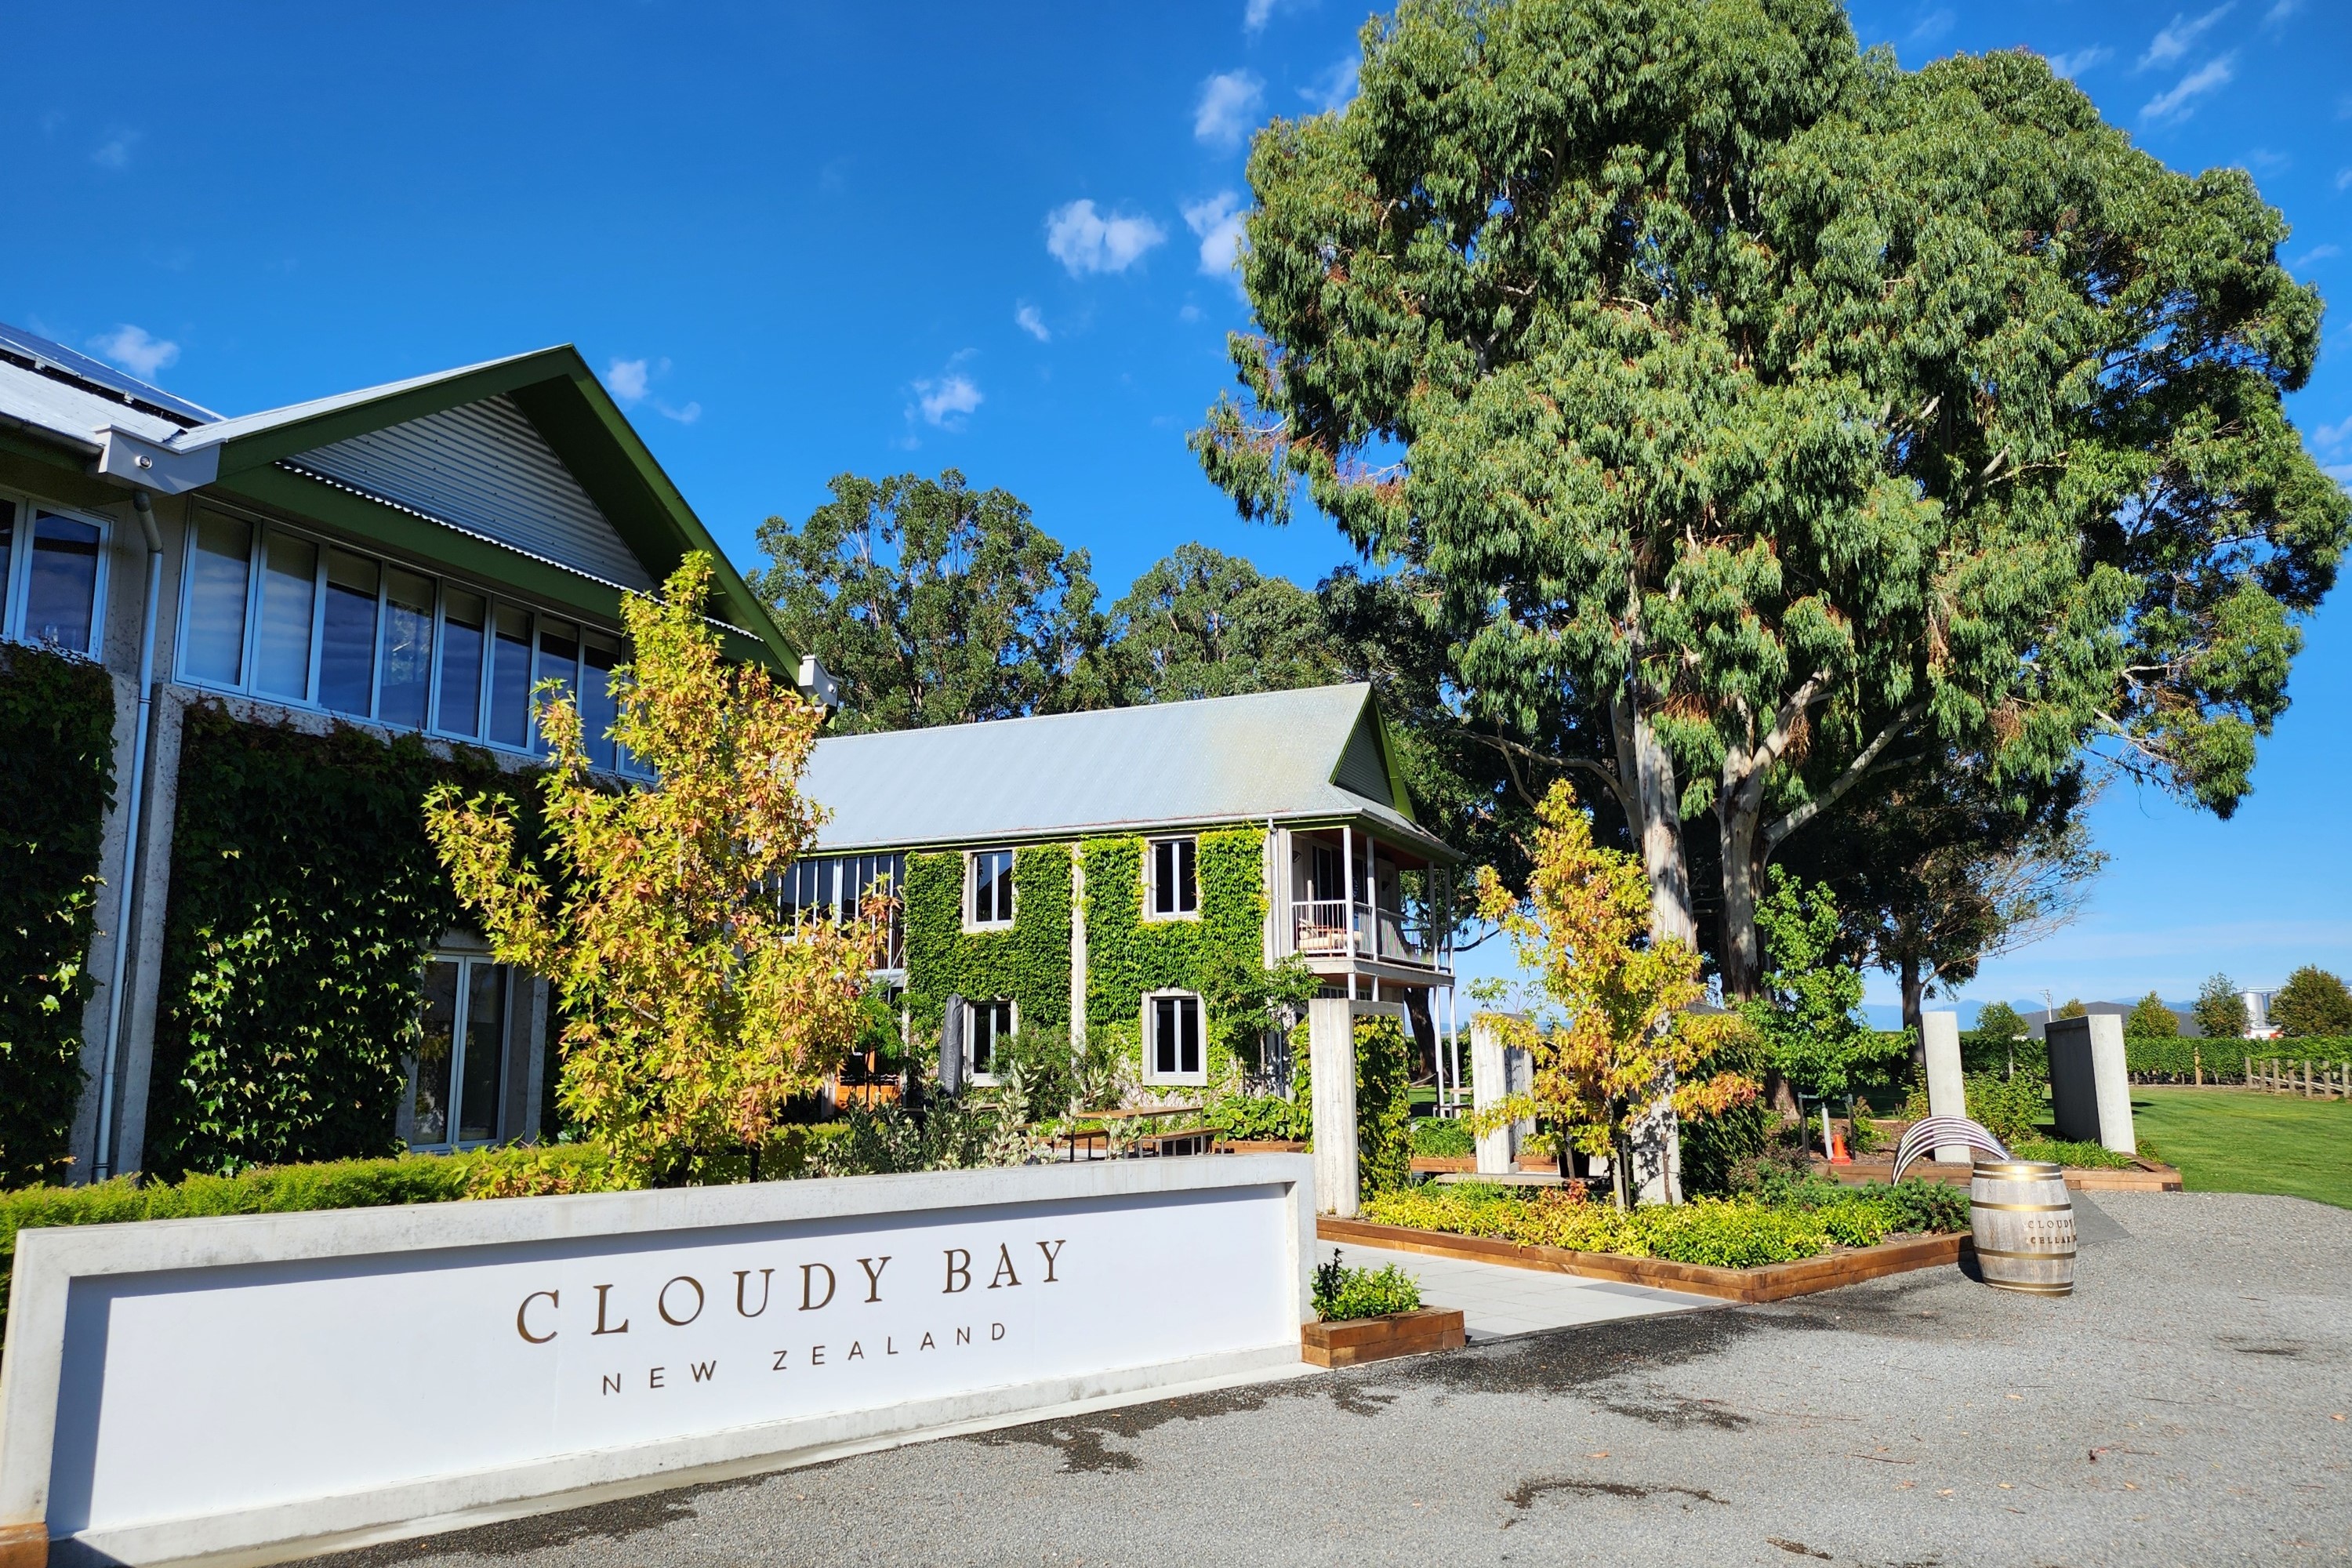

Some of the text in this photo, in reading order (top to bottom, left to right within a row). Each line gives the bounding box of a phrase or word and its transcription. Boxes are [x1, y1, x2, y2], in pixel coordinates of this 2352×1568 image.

[2030, 1236, 2071, 1244] CELLAR
[517, 1240, 1066, 1345] CLOUDY BAY
[603, 1323, 1005, 1396] NEW ZEALAND
